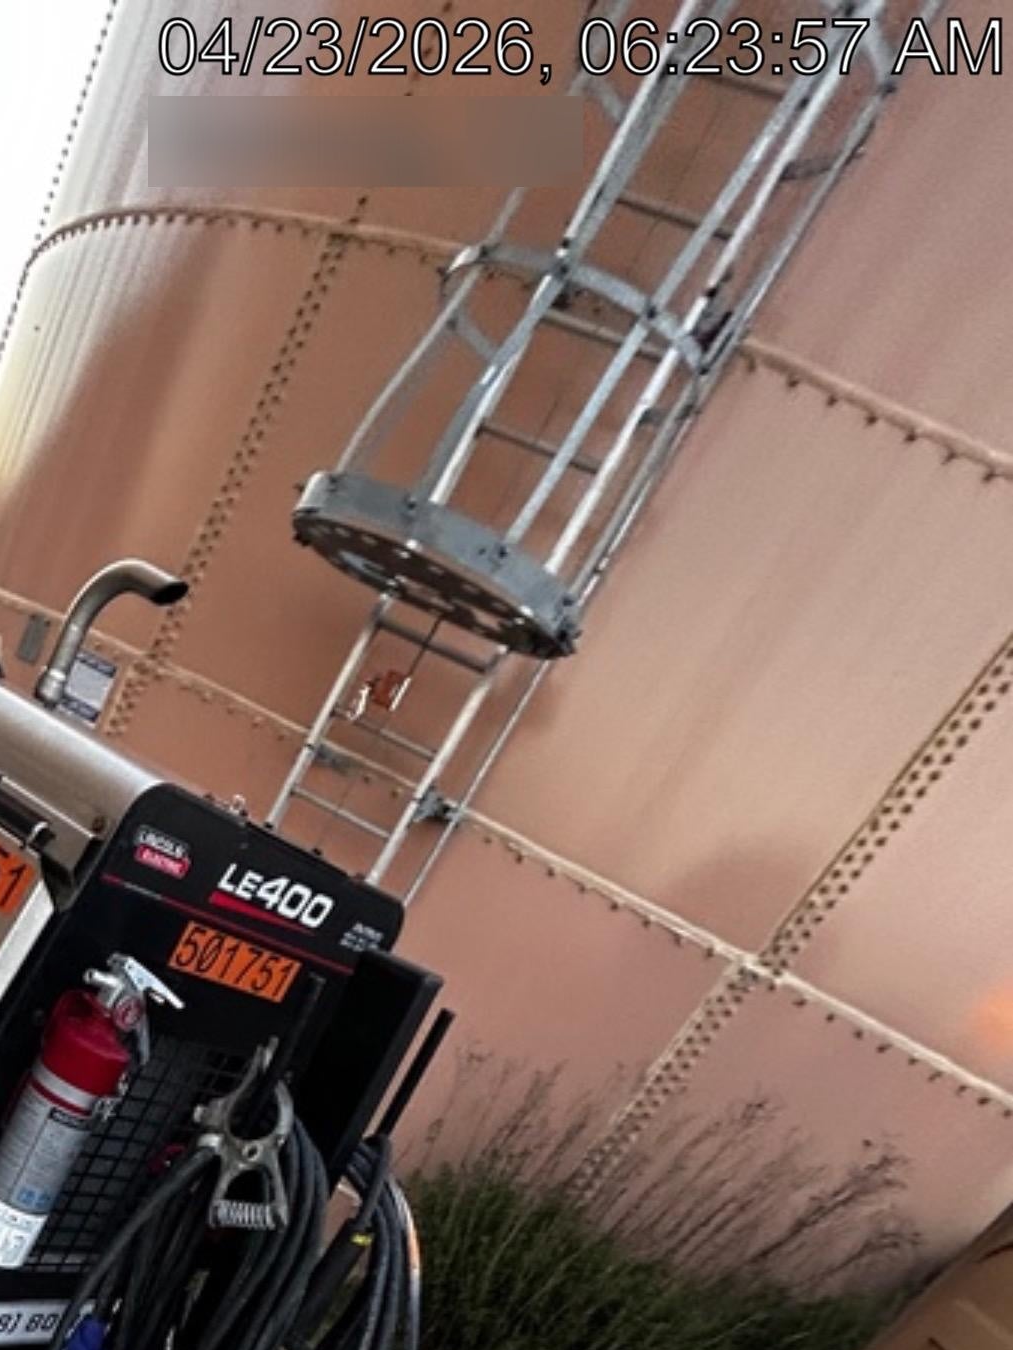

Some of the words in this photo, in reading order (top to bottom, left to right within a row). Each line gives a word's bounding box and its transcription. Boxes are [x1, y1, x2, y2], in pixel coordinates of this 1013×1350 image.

[217, 863, 334, 928] LE400
[176, 928, 295, 999] 501751
[25, 1313, 59, 1334] 80
